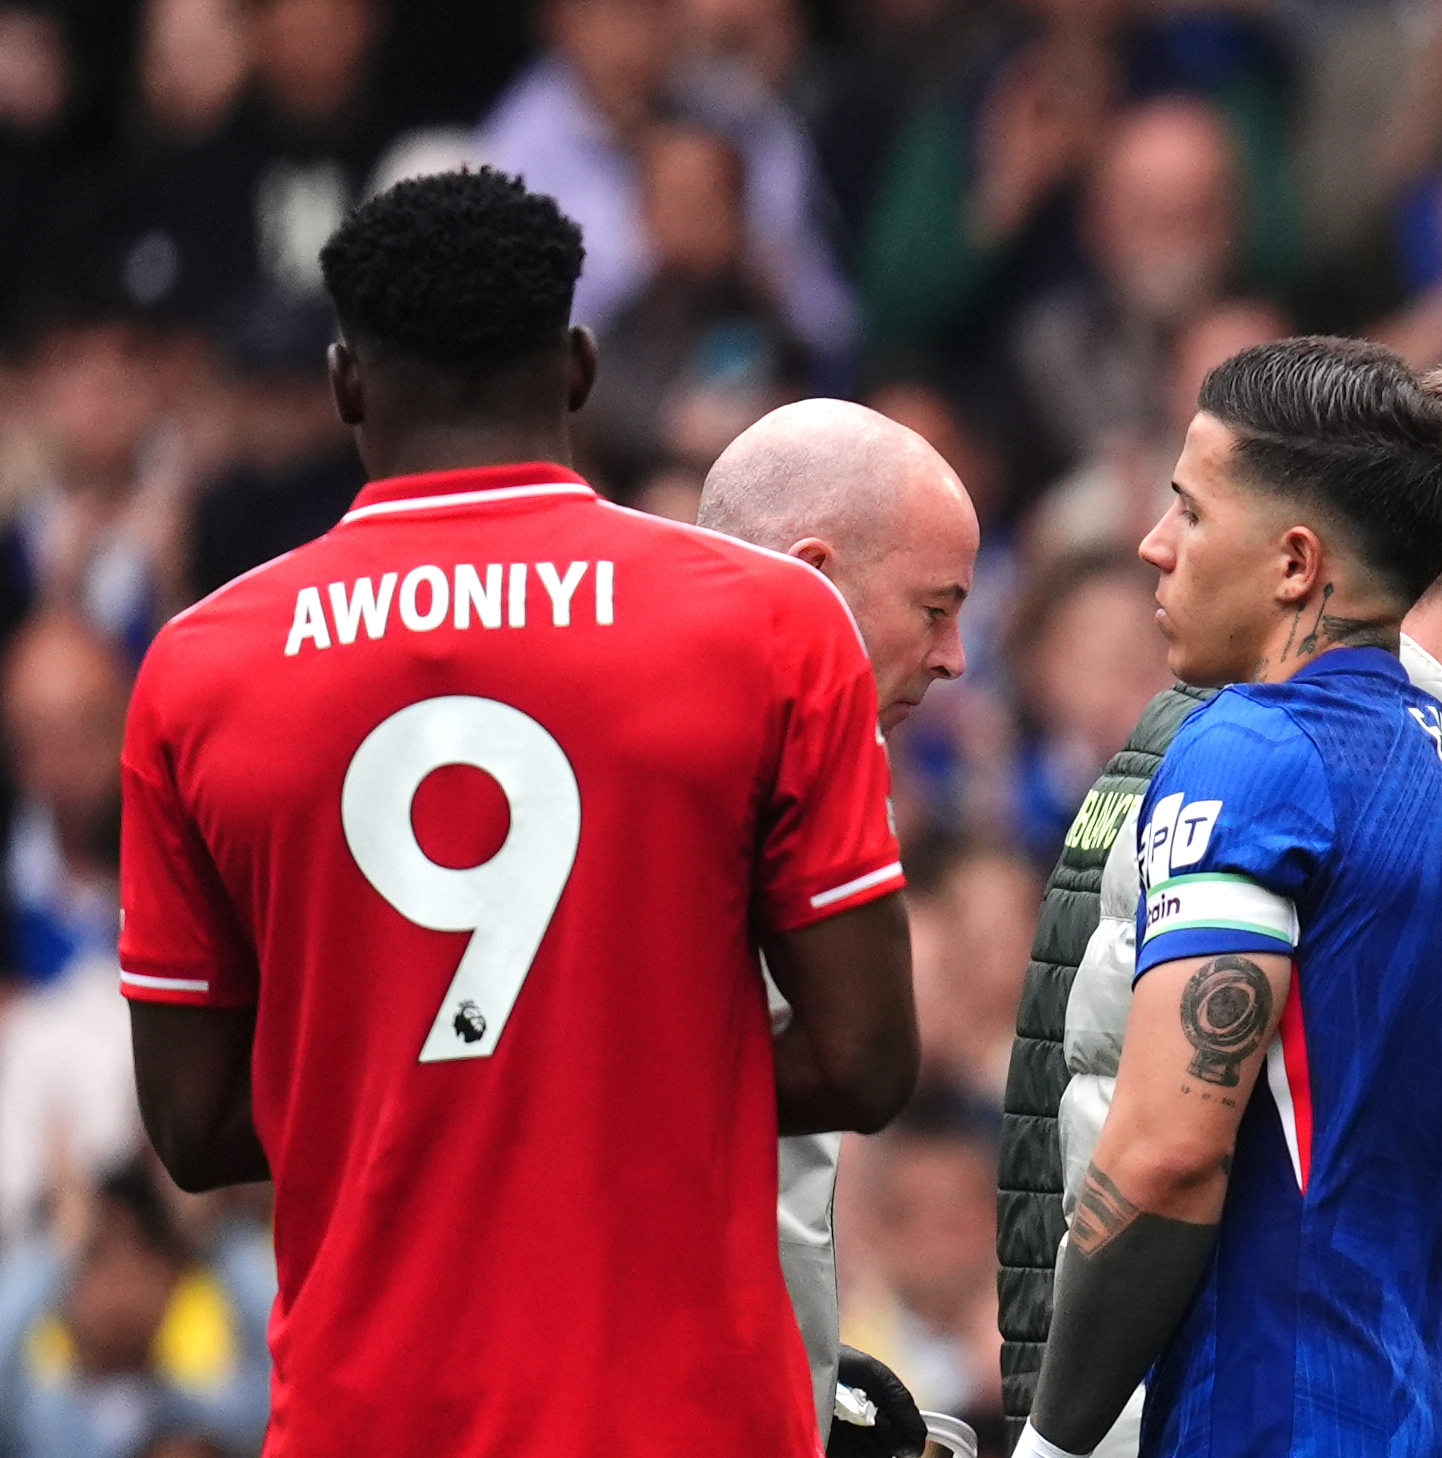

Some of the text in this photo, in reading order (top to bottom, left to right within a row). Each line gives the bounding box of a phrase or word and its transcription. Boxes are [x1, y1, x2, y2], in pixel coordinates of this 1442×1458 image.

[285, 560, 615, 656] AWONIYI
[341, 695, 581, 1062] 9
[1147, 893, 1181, 926] ain
